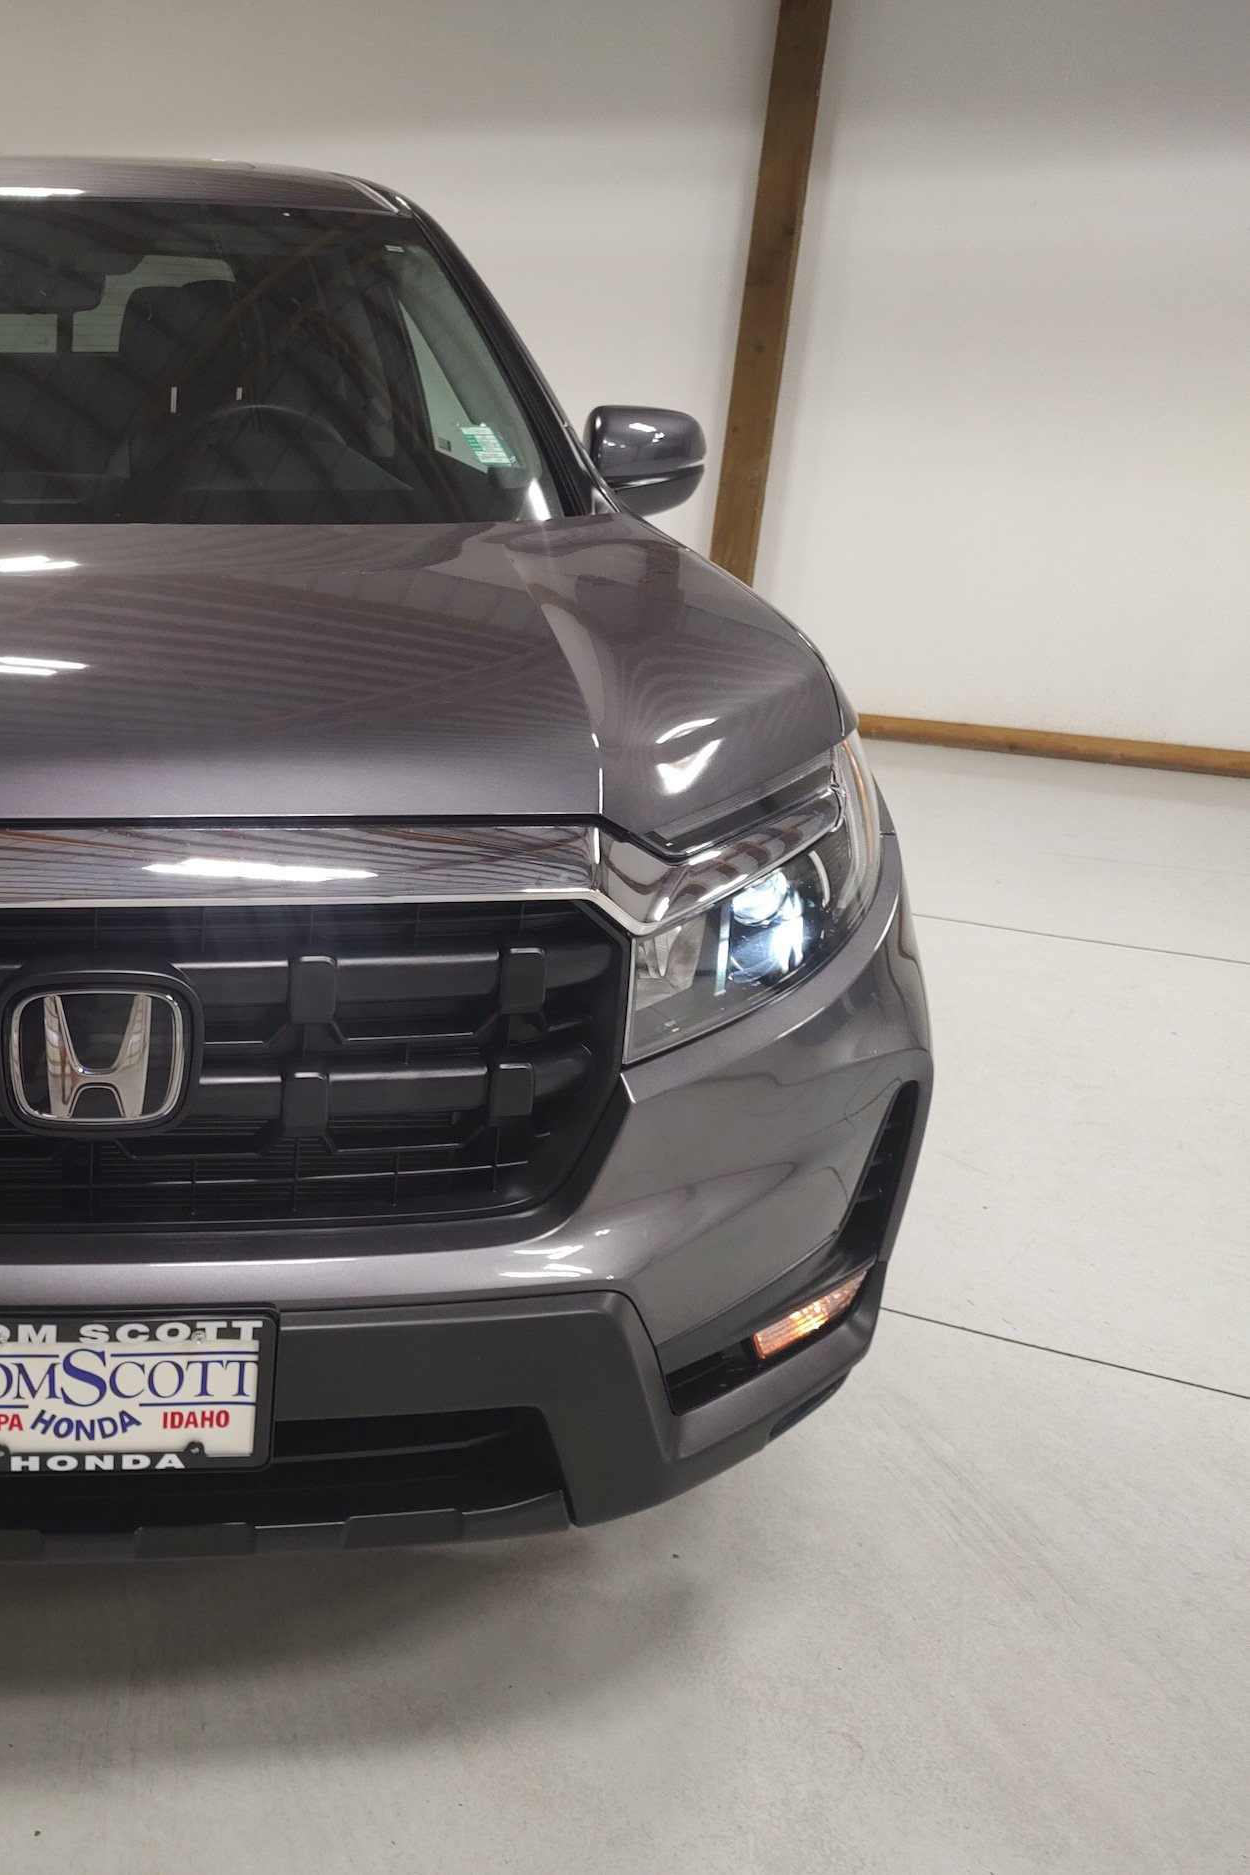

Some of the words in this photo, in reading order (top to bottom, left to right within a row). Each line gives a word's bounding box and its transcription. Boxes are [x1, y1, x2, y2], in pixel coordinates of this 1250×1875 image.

[79, 1320, 263, 1343] SCOTT
[30, 1409, 142, 1441] HONDA
[162, 1410, 230, 1430] IDAHO
[10, 1453, 186, 1472] HONDA
